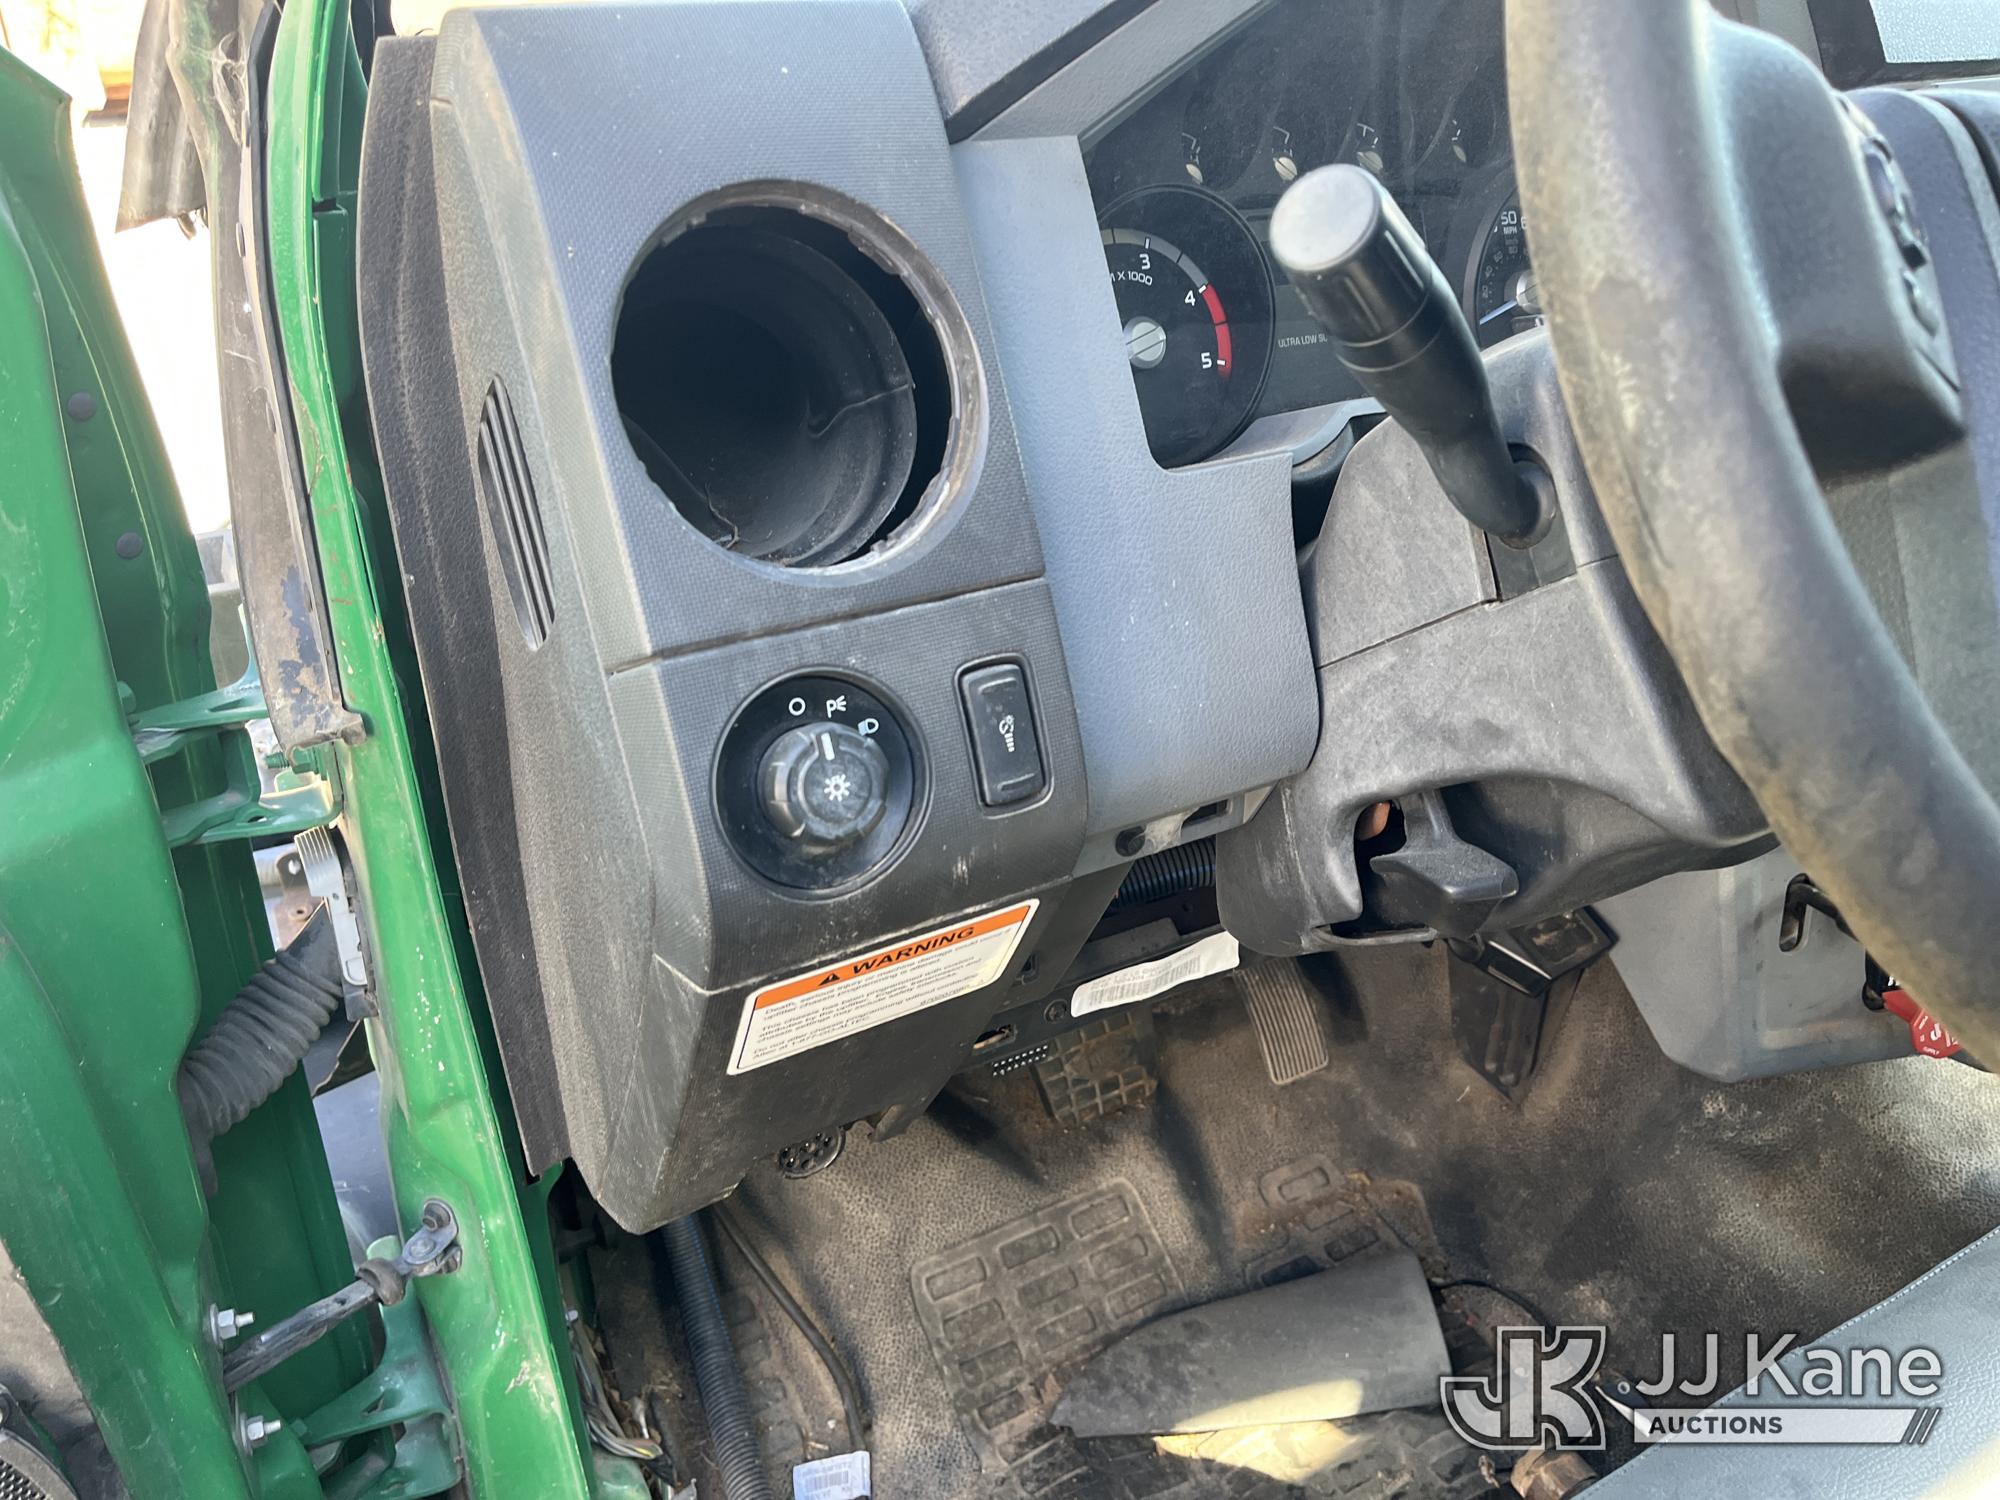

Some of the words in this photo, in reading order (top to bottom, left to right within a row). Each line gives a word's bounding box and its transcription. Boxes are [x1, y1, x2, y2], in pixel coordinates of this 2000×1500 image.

[1501, 211, 1517, 225] 50
[1503, 226, 1517, 234] MPH
[1139, 253, 1151, 270] 3
[1117, 271, 1126, 281] X
[1128, 270, 1153, 286] 1000
[1184, 290, 1196, 306] 4
[1278, 336, 1301, 348] ULTRA
[1301, 334, 1317, 345] LOW
[1201, 352, 1212, 369] 5
[850, 926, 976, 975] WARNING
